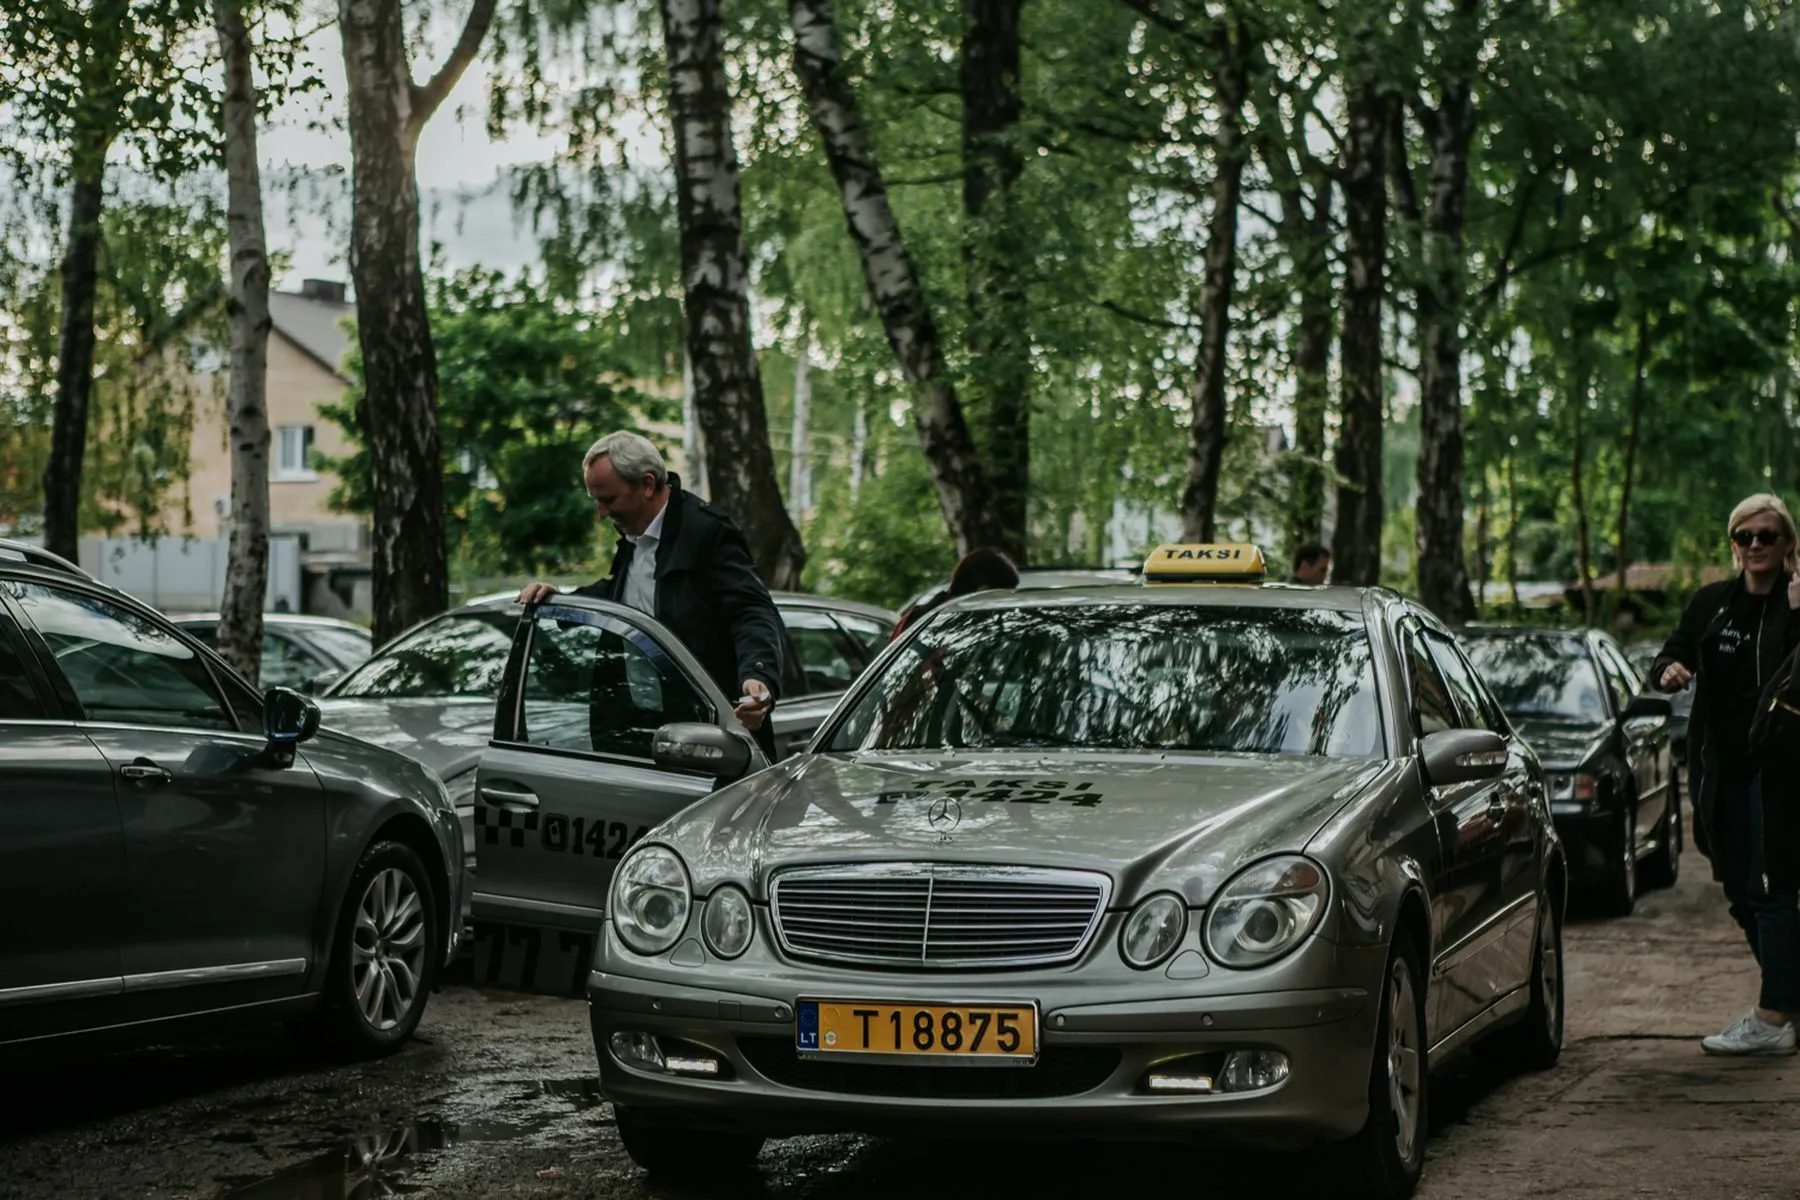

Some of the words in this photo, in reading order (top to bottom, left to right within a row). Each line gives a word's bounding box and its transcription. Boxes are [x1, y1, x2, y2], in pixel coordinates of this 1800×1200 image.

[1164, 549, 1241, 559] TAKSI
[910, 779, 1094, 791] TAKSI
[945, 789, 1104, 807] 1424
[853, 1009, 1021, 1052] T18875
[800, 1032, 817, 1044] LT
